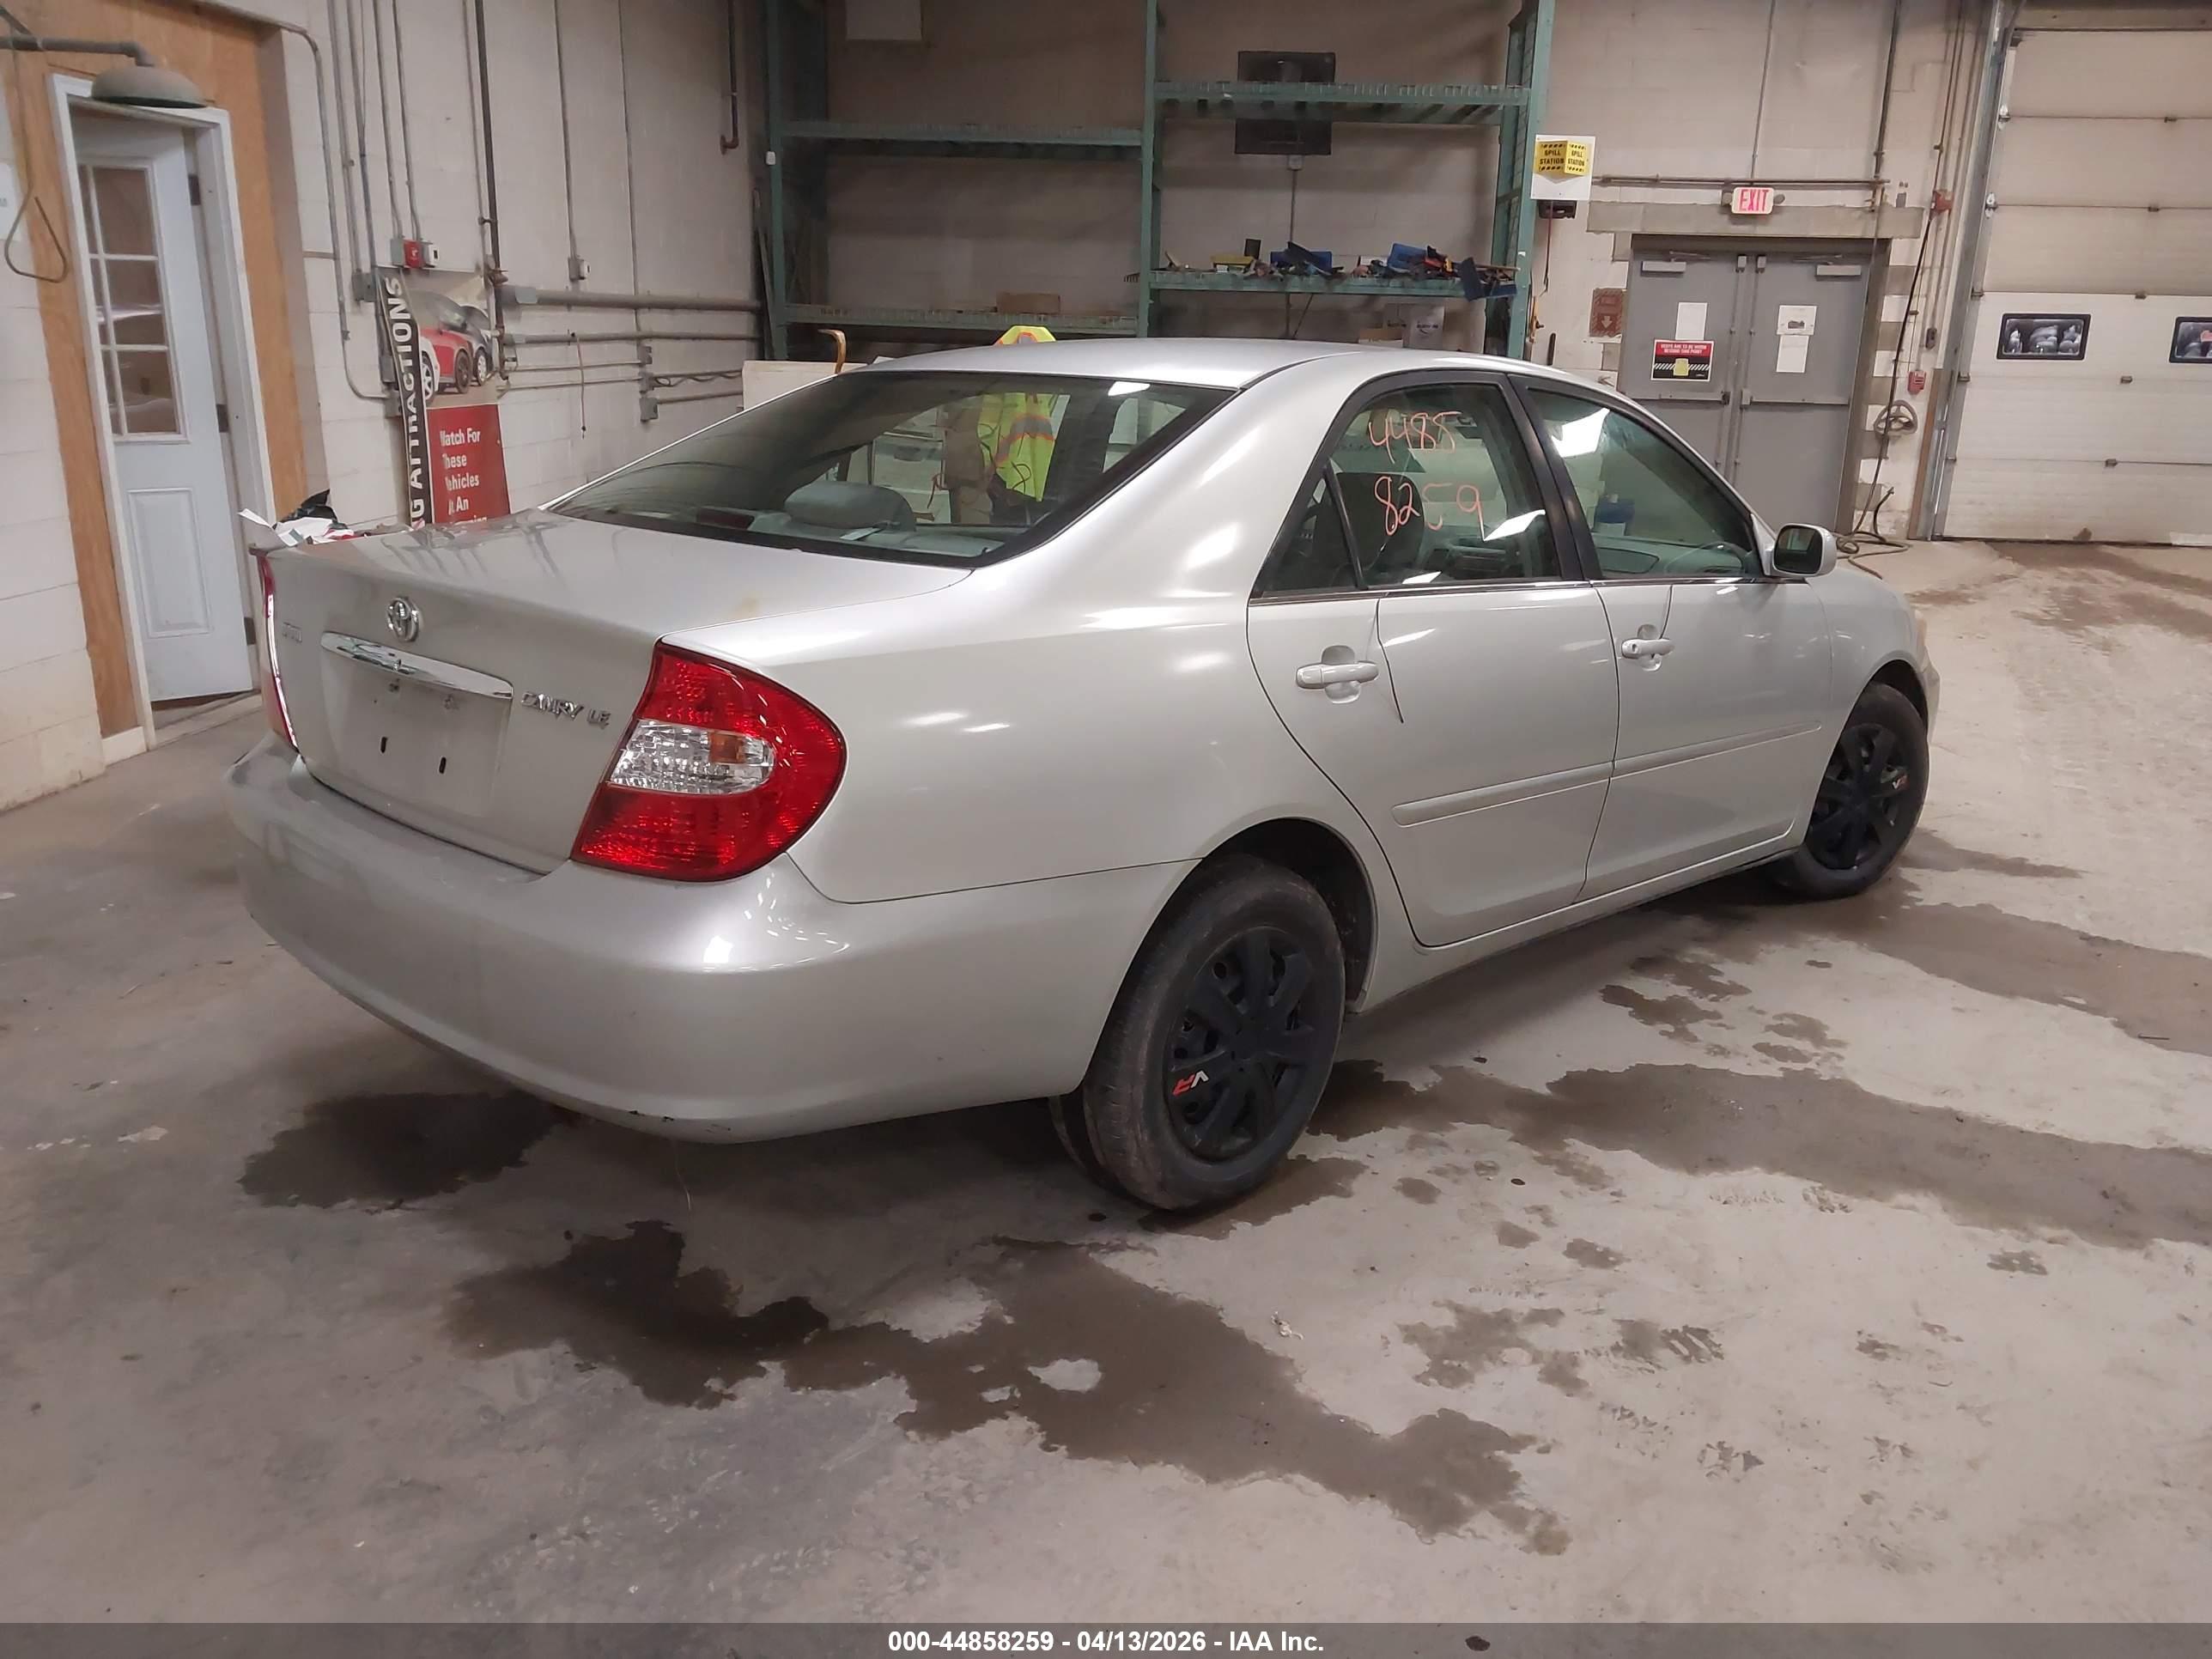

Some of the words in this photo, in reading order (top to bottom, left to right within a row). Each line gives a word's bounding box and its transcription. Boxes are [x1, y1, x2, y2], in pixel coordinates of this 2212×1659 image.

[1740, 188, 1770, 212] EXIT
[466, 428, 481, 443] For
[1368, 410, 1462, 465] 4485
[456, 496, 469, 512] An
[1374, 476, 1486, 542] 8259
[520, 691, 584, 720] CAMRY
[586, 708, 611, 729] LE
